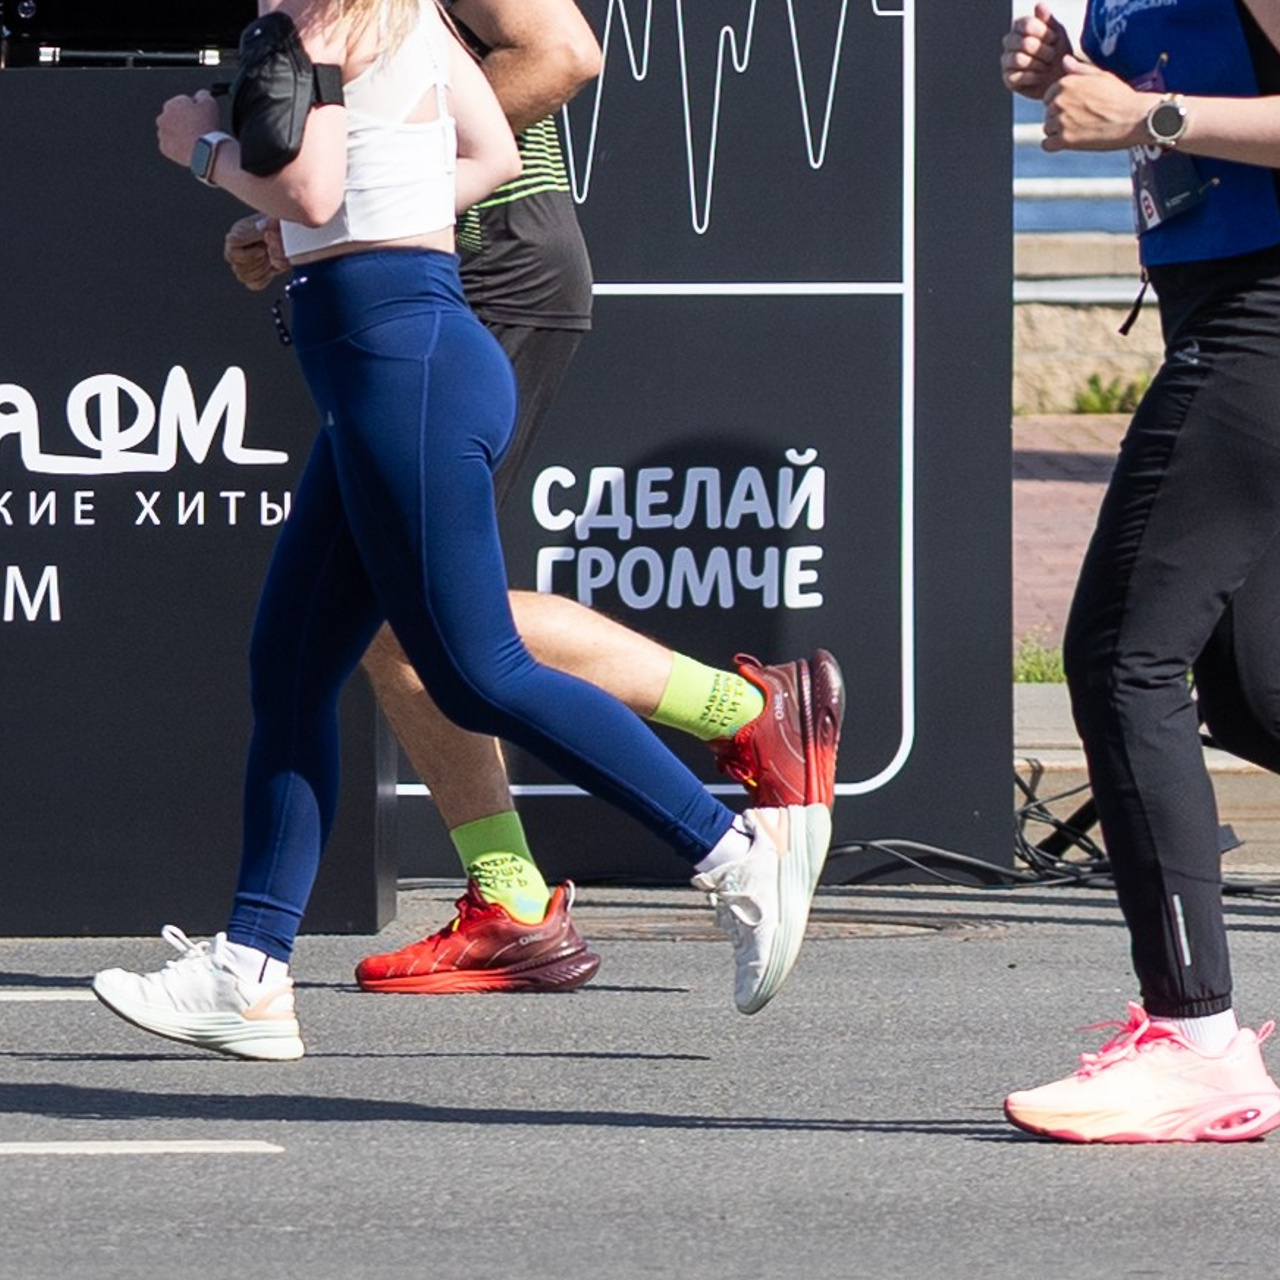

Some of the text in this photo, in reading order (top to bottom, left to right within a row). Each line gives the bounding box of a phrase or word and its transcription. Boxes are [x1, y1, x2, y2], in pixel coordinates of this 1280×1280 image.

[66, 364, 290, 476] ФМ
[134, 491, 292, 526] ХИТЫ
[531, 447, 826, 541] СДЕЛАЙ
[536, 545, 824, 609] ГРОМЧЕ
